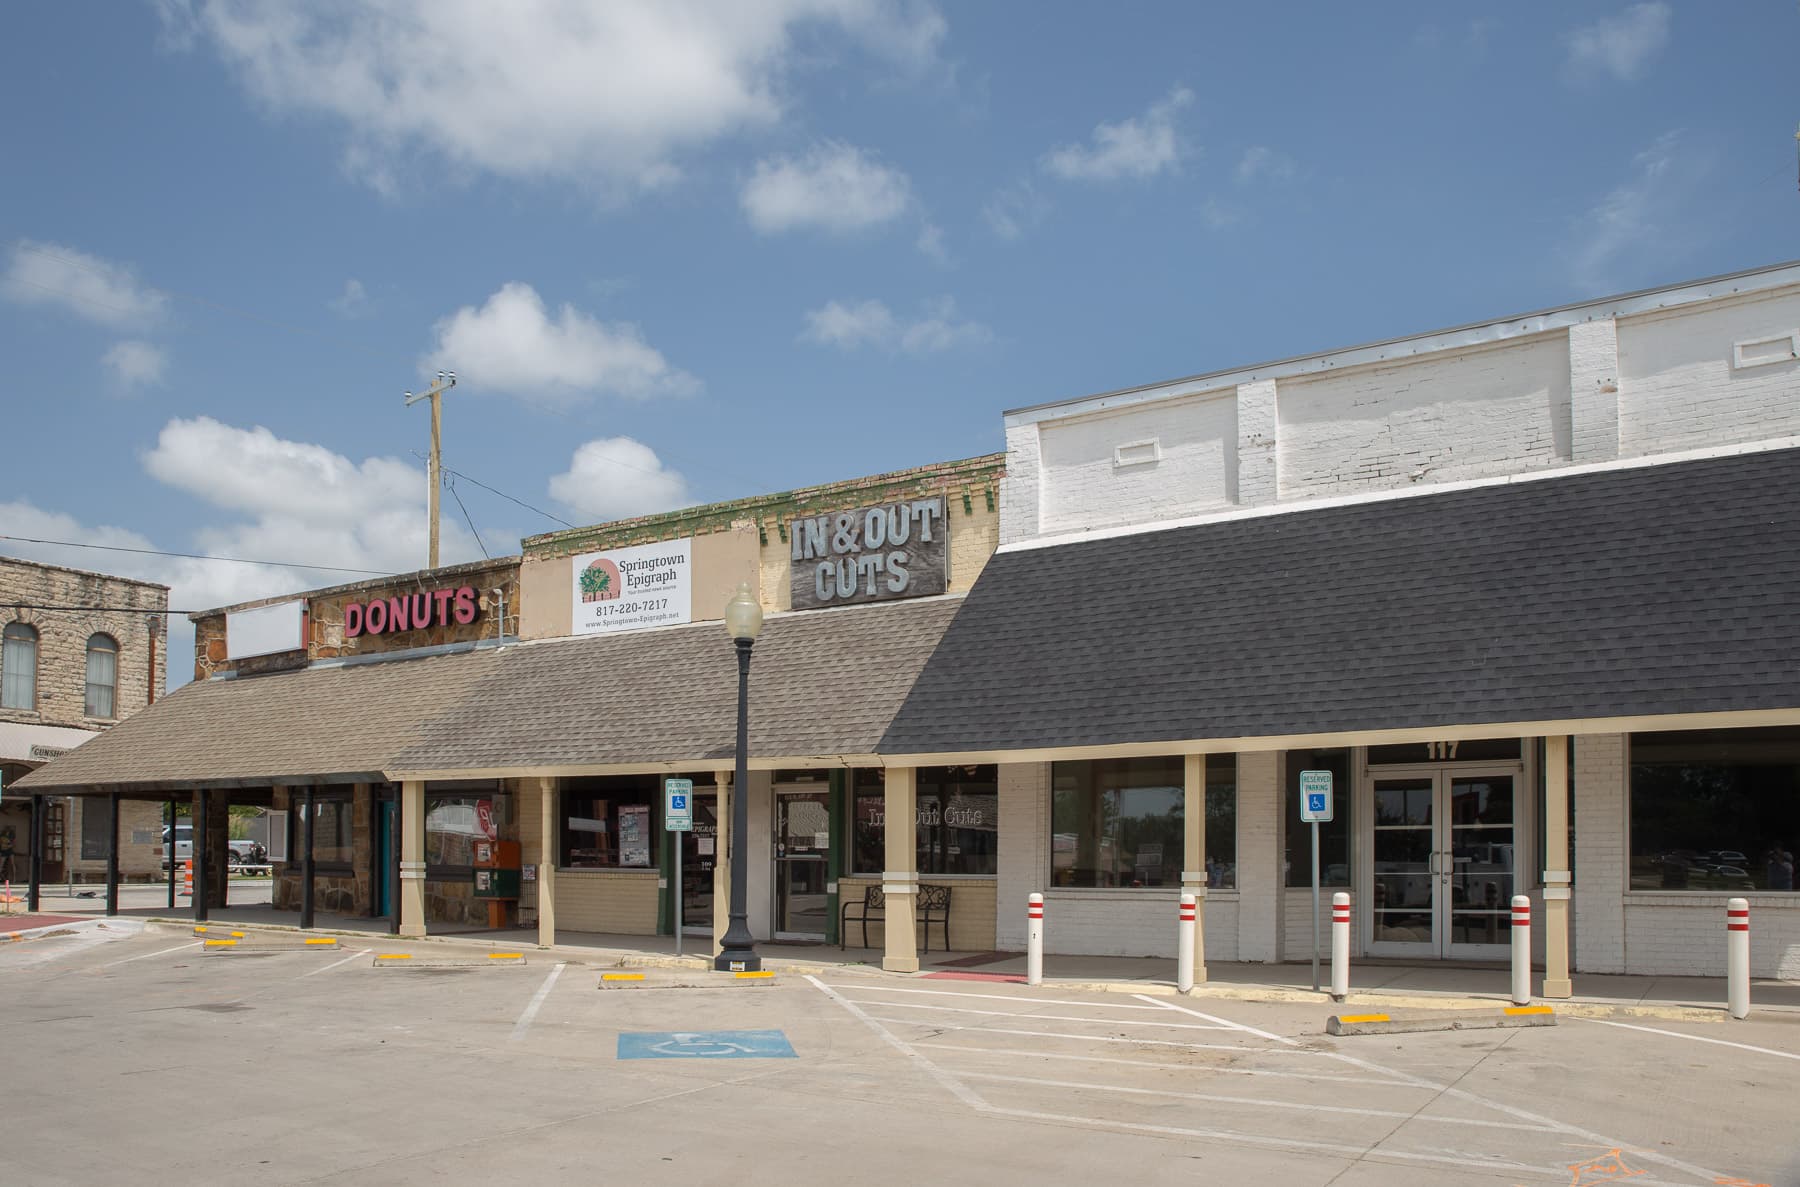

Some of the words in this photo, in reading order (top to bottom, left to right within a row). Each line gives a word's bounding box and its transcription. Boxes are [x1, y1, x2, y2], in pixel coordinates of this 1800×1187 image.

[619, 554, 685, 575] Springtown
[626, 569, 677, 589] Epigraph
[815, 550, 910, 601] CUTS
[345, 584, 478, 638] DONUTS
[596, 598, 668, 617] 817-220-7217
[34, 748, 68, 758] GUNSHO
[1427, 741, 1460, 760] 117
[1303, 774, 1331, 783] RESERVED
[1305, 783, 1329, 792] PARKING
[944, 806, 983, 825] Cuts
